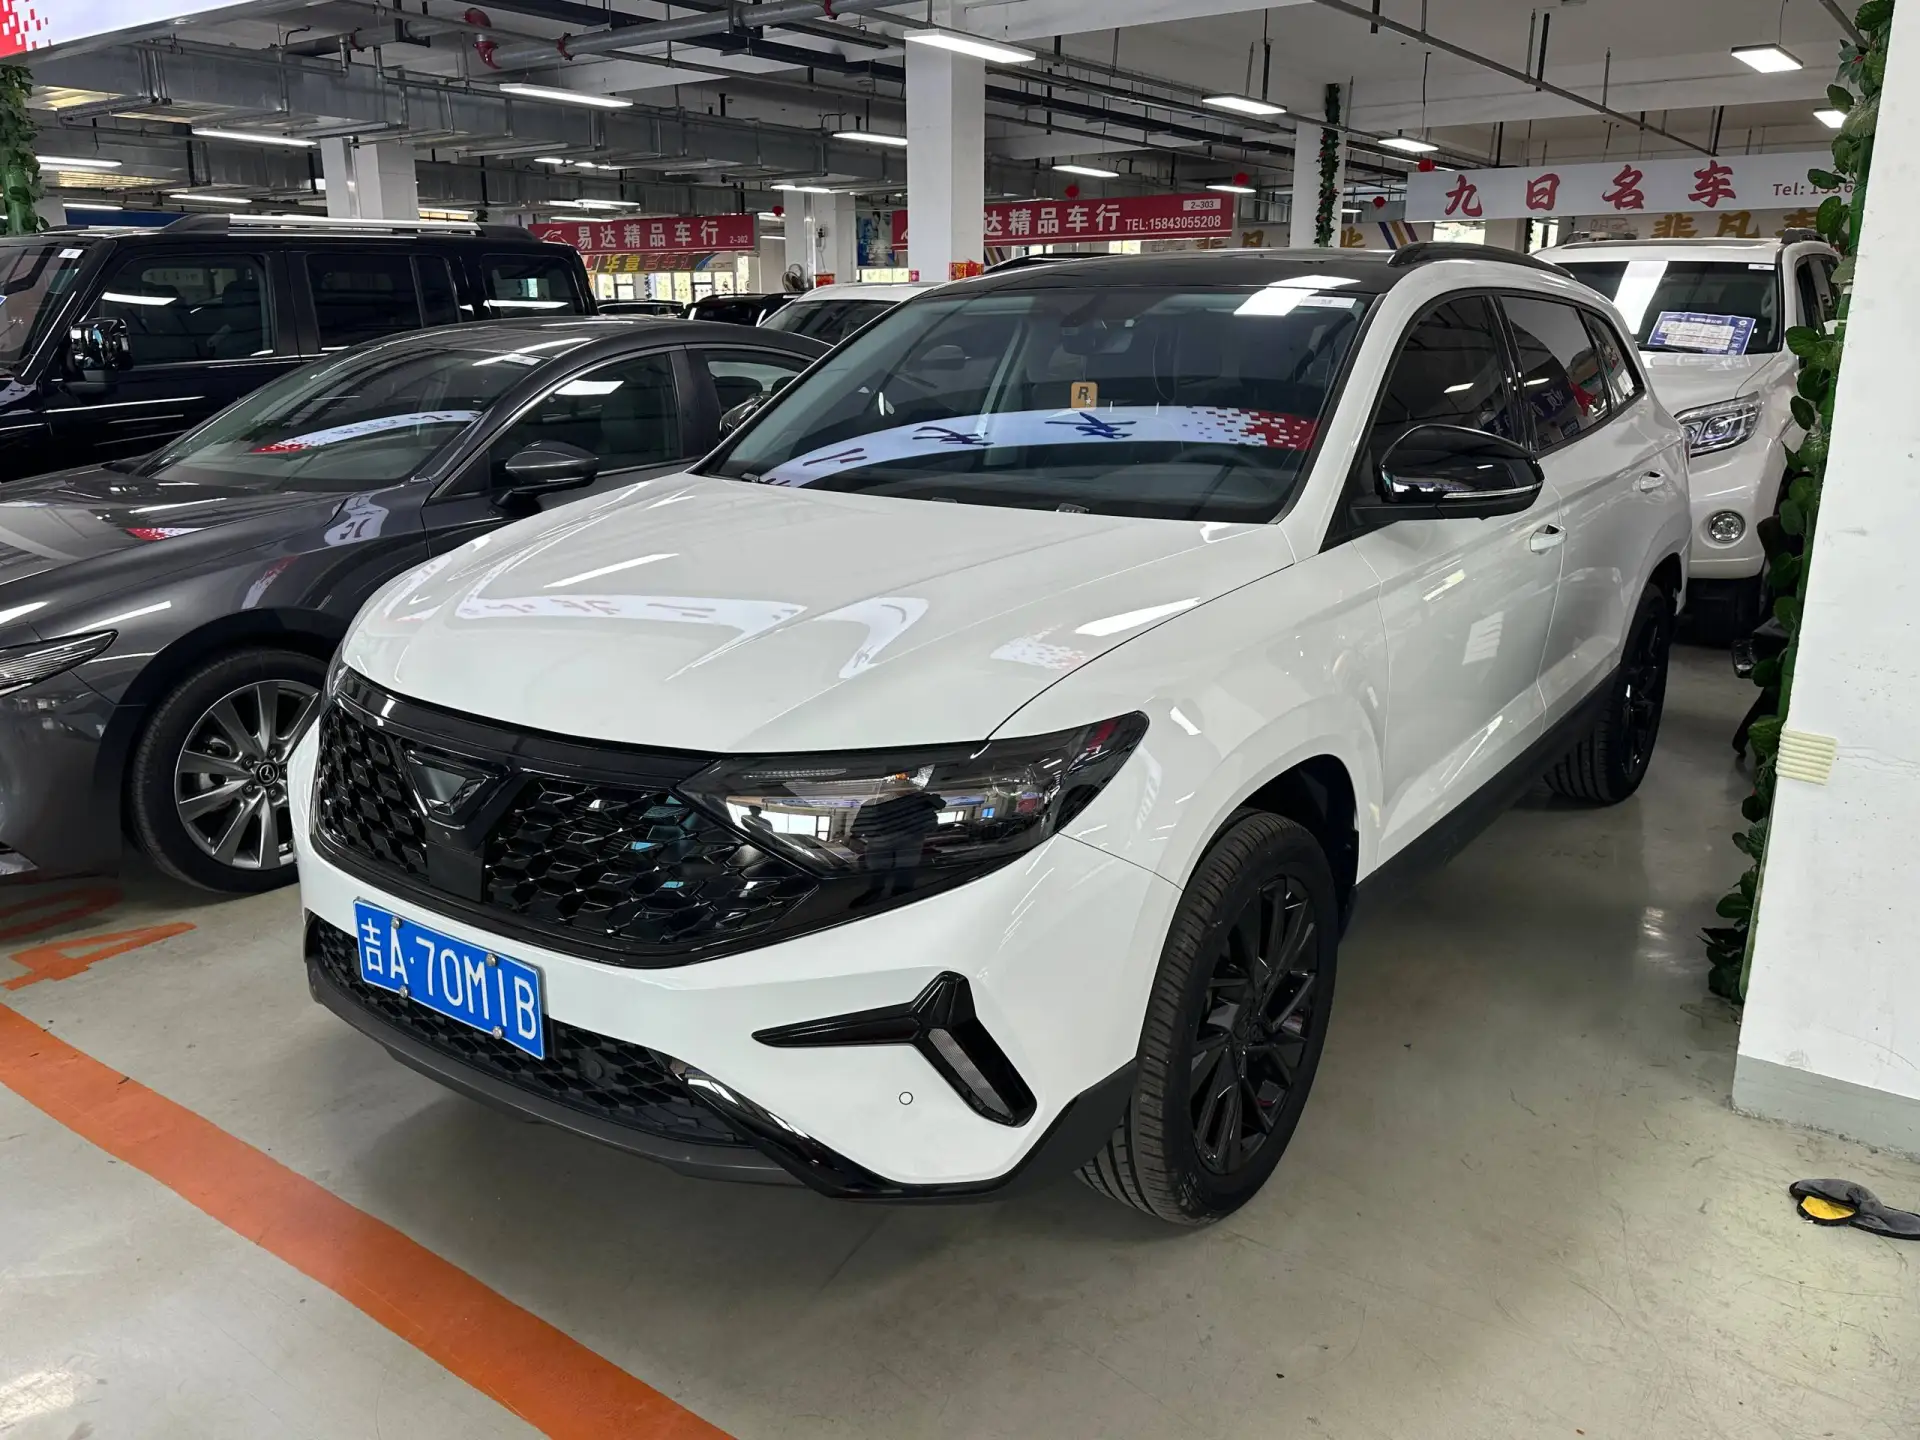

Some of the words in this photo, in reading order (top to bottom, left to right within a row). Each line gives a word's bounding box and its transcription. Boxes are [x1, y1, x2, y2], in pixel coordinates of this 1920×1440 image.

[1444, 159, 1737, 218] 九日名车
[1773, 182, 1804, 196] Tel:
[1190, 200, 1214, 209] 2-303
[1125, 215, 1221, 231] TEL:15843055208
[577, 219, 719, 250] 易达精品车行
